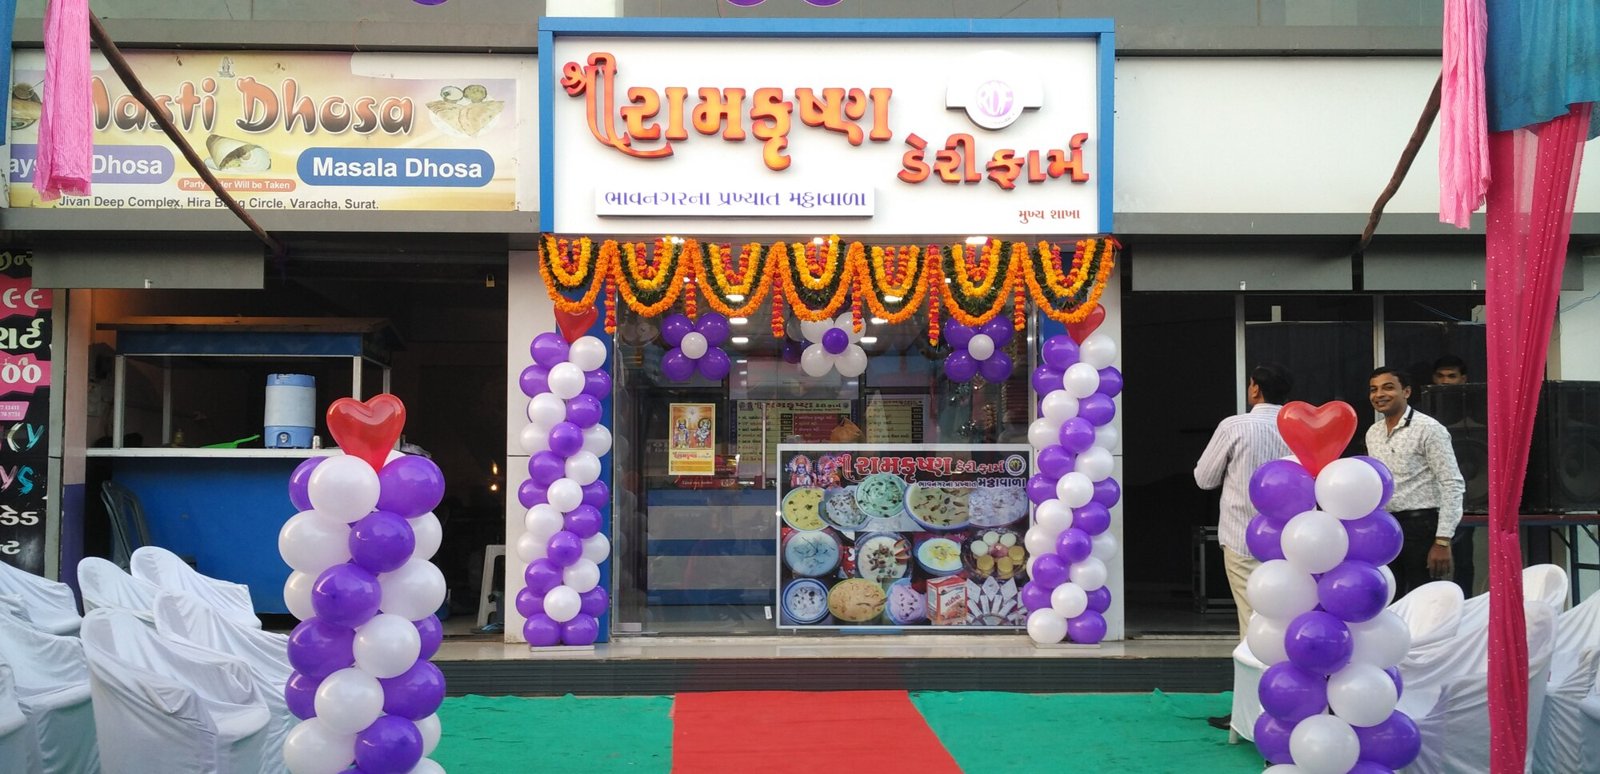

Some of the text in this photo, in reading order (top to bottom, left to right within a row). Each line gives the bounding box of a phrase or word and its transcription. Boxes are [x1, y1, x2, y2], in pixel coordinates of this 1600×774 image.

[92, 77, 414, 136] asti Dhosa
[560, 52, 893, 171] શ્રી રામકૃષ્ણ
[93, 154, 163, 175] Dhosa
[313, 157, 482, 178] Masala Dhosa
[897, 132, 1090, 190] ડેરી ફાર્મ
[183, 180, 206, 189] Party
[234, 181, 250, 189] Will
[252, 181, 262, 189] be
[265, 181, 290, 189] Taken
[59, 196, 90, 206] Jivan
[94, 196, 124, 208] Deep
[128, 197, 183, 209] Complex,
[187, 197, 211, 208] Hira
[249, 198, 286, 209] Circle,
[290, 198, 341, 209] Varacha,
[345, 198, 379, 209] Surat.
[605, 191, 710, 206] ભાવનગરના
[718, 191, 780, 206] પ્રખ્યાત
[1019, 209, 1080, 224] મુખ્ય શાખા
[854, 457, 953, 485] રામકૃષ્ણ
[956, 459, 977, 474] ડેરી
[978, 459, 1006, 475] ફાર્મ
